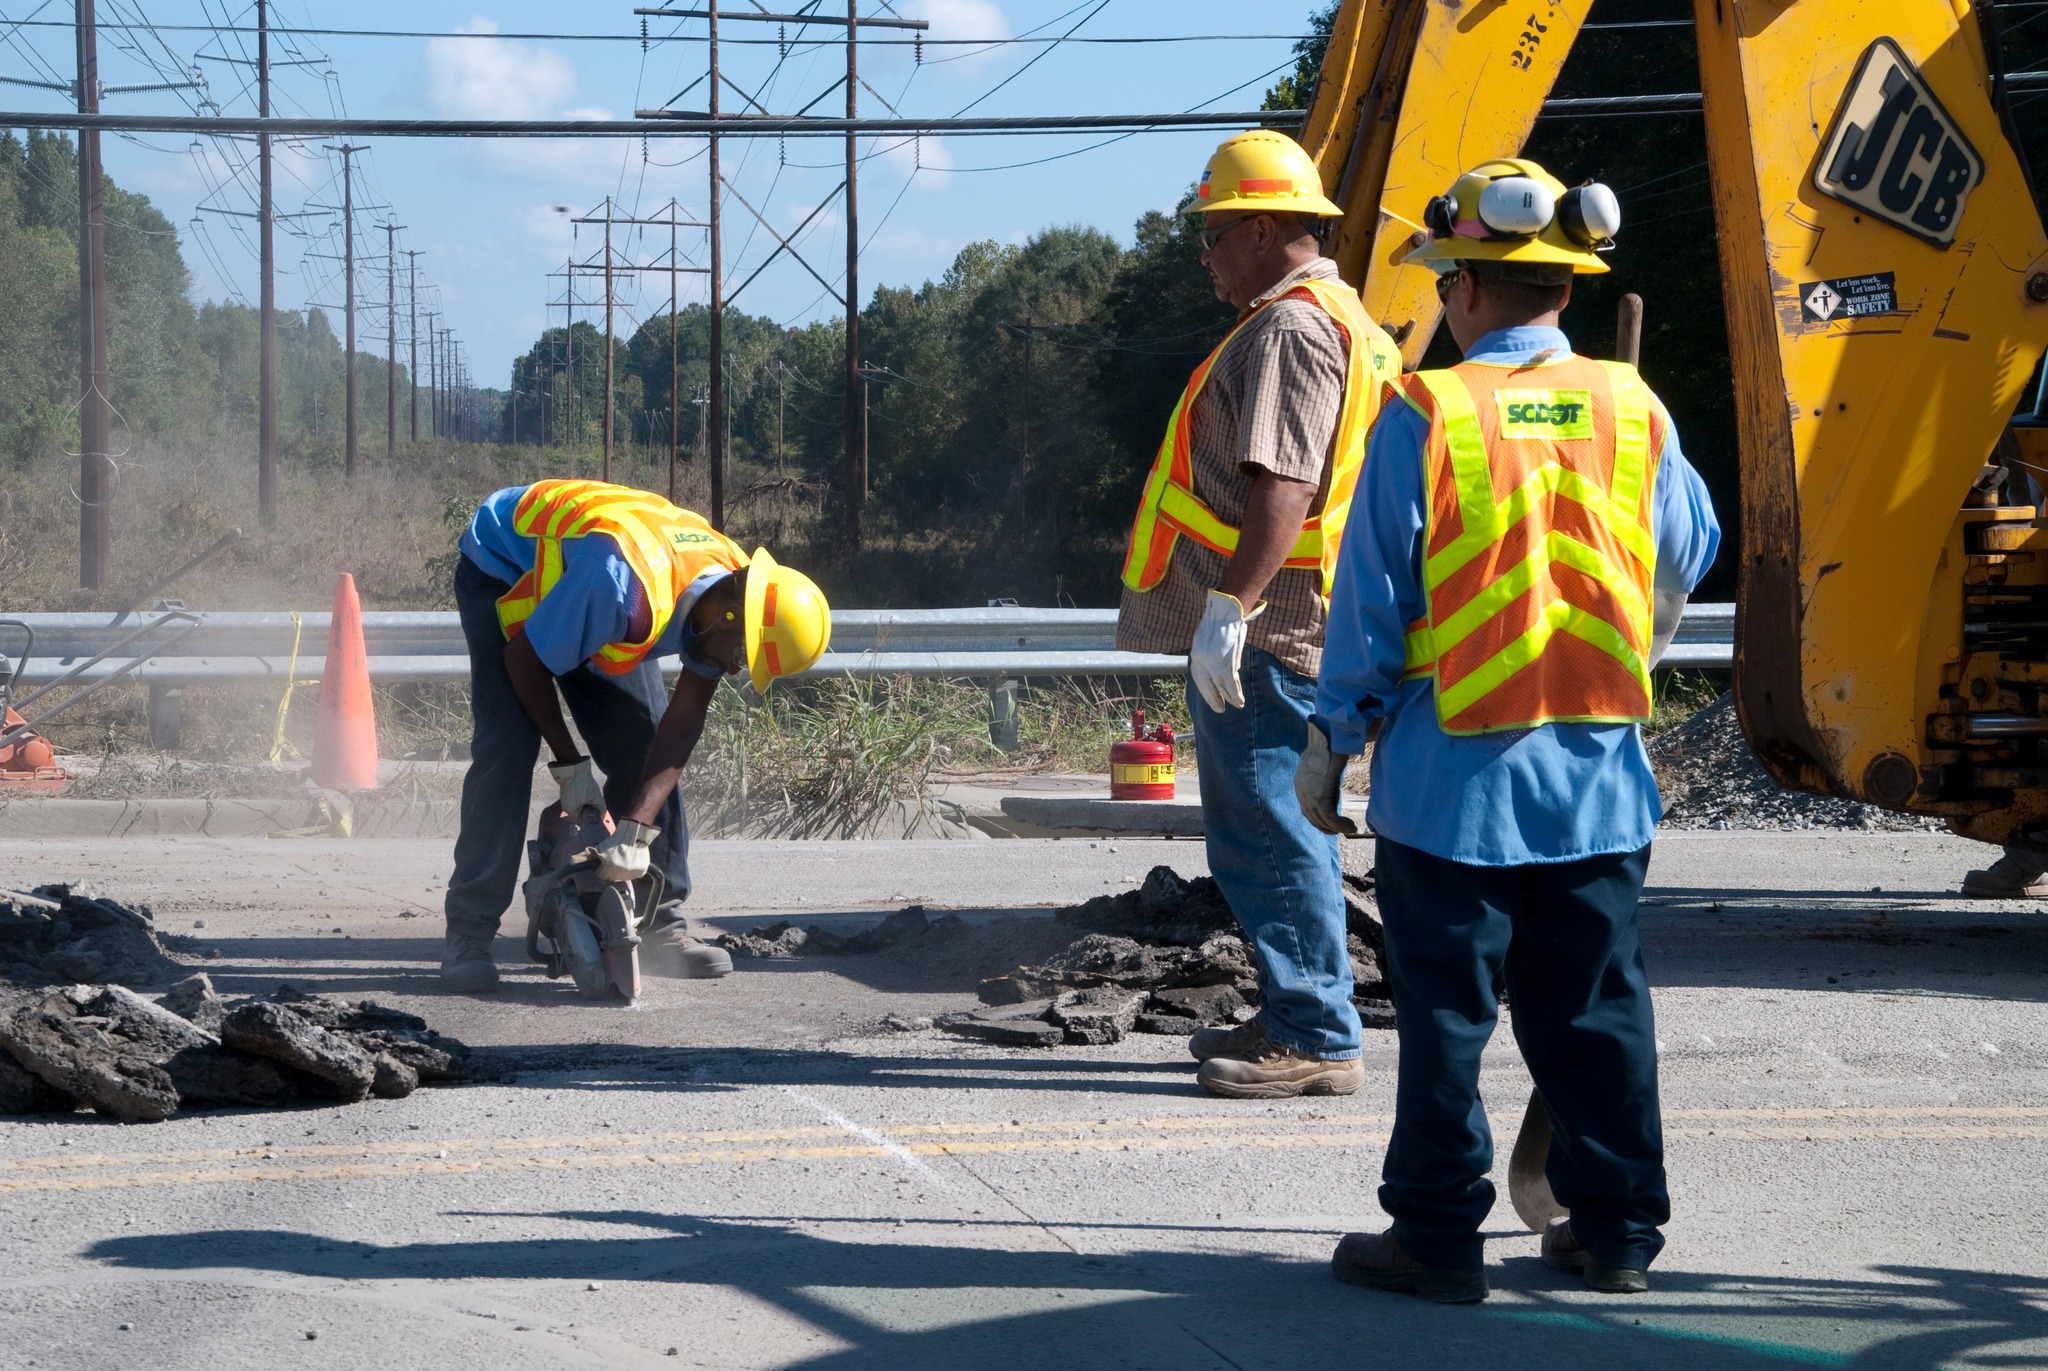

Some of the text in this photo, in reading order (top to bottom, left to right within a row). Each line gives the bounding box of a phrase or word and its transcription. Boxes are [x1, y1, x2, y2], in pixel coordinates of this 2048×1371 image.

[1825, 64, 1970, 231] JCB
[1845, 292, 1890, 305] WORK ZONE
[1847, 300, 1890, 315] SAFETY
[1508, 404, 1584, 426] SCDOT
